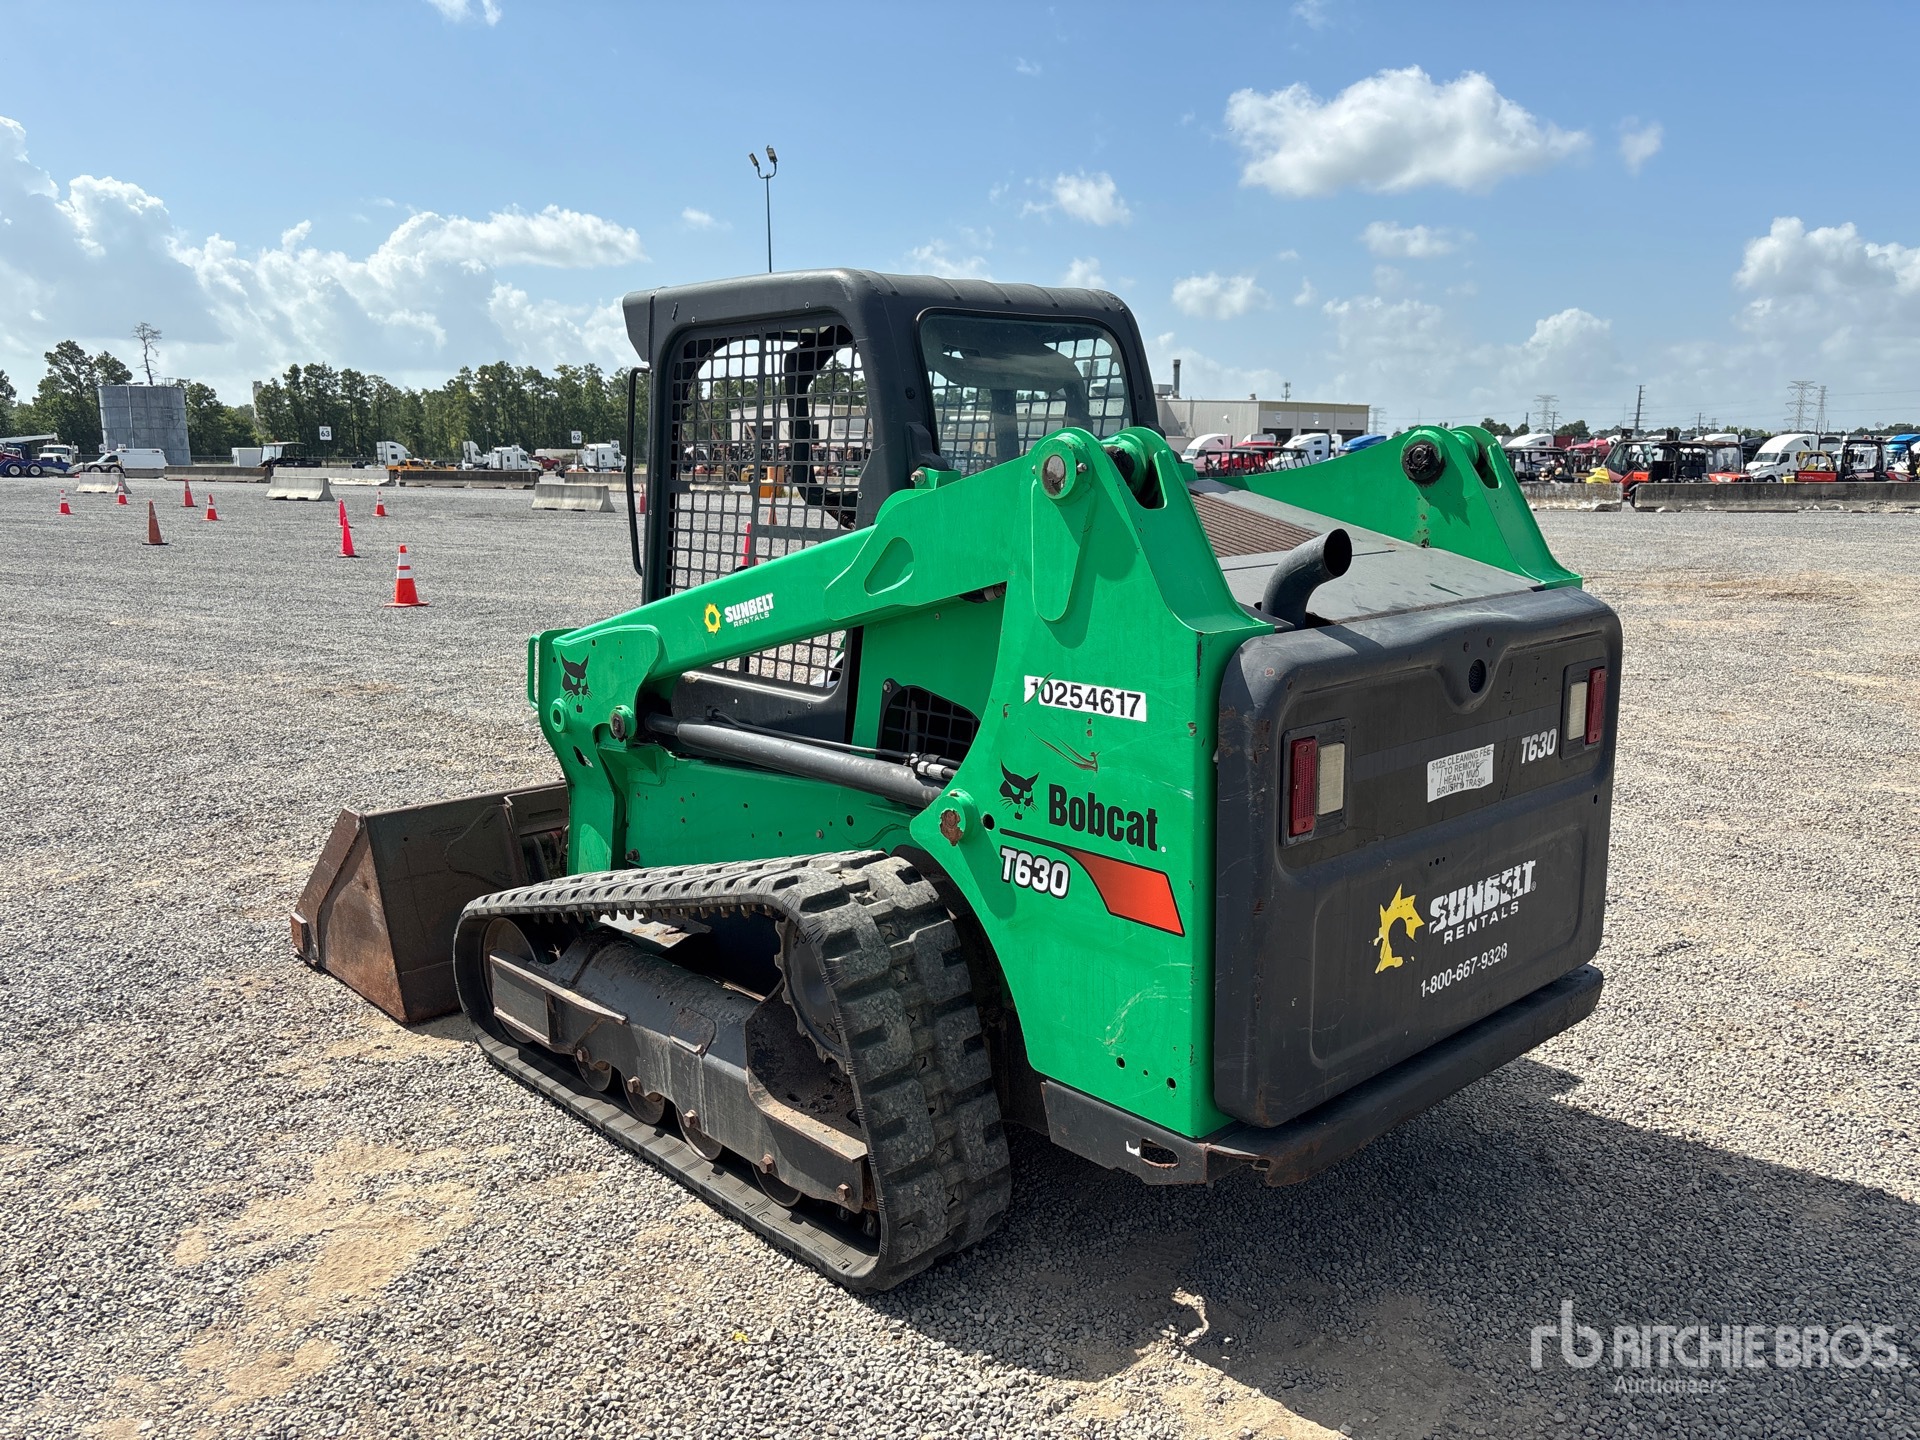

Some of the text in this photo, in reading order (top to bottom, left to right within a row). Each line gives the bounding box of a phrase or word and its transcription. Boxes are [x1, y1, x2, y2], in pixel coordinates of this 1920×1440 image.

[724, 593, 774, 623] SUNBELT
[733, 611, 770, 628] RENTALS
[1447, 751, 1479, 765] CLEANING
[1480, 747, 1491, 758] FEE
[1521, 728, 1557, 764] T630
[1443, 772, 1465, 785] HEAVY
[1444, 759, 1480, 776] TO REMOVE
[1436, 782, 1459, 797] BRUSH
[1466, 776, 1486, 788] TRASH
[1048, 783, 1158, 852] Bobcat
[1000, 846, 1070, 899] T630
[1443, 901, 1520, 945] RENTALS
[1420, 942, 1508, 998] 1-800-667-9328
